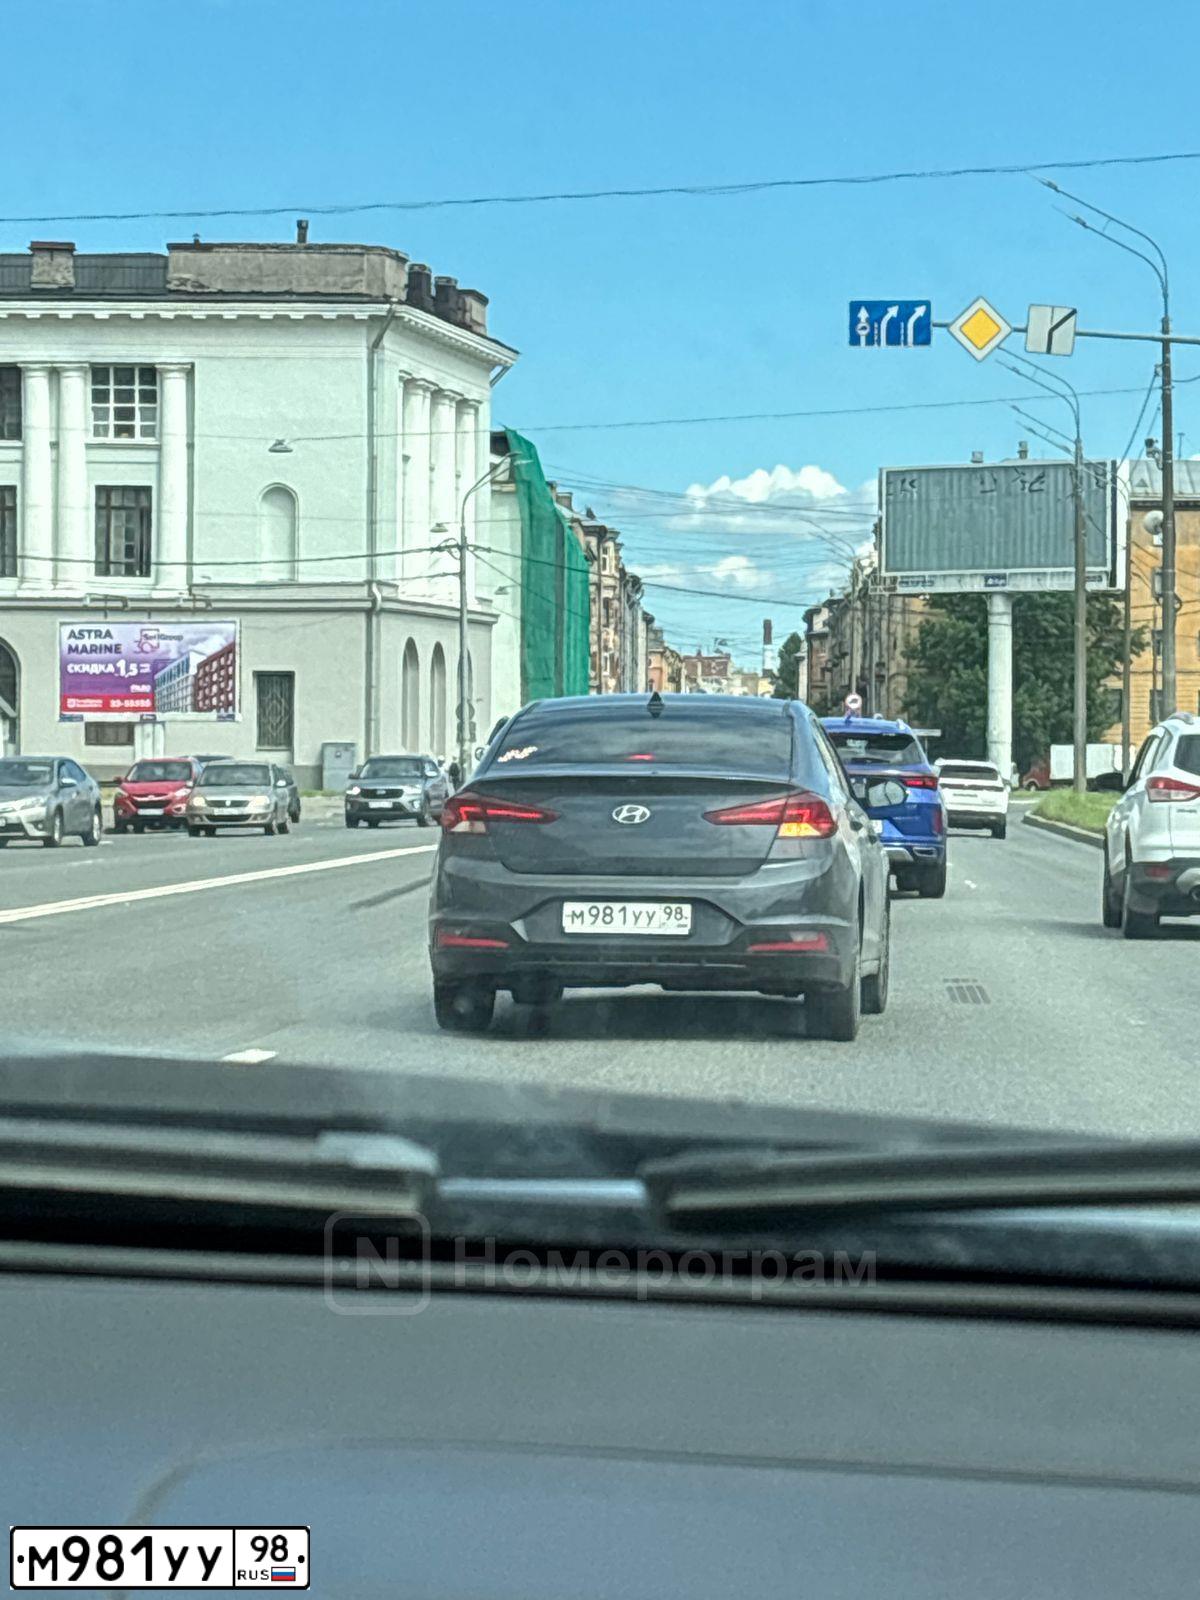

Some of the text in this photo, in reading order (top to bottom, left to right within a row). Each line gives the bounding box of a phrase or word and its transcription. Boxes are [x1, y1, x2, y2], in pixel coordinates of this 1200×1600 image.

[67, 629, 113, 640] ASTRA
[67, 643, 122, 655] MARINE
[663, 905, 683, 921] 98
